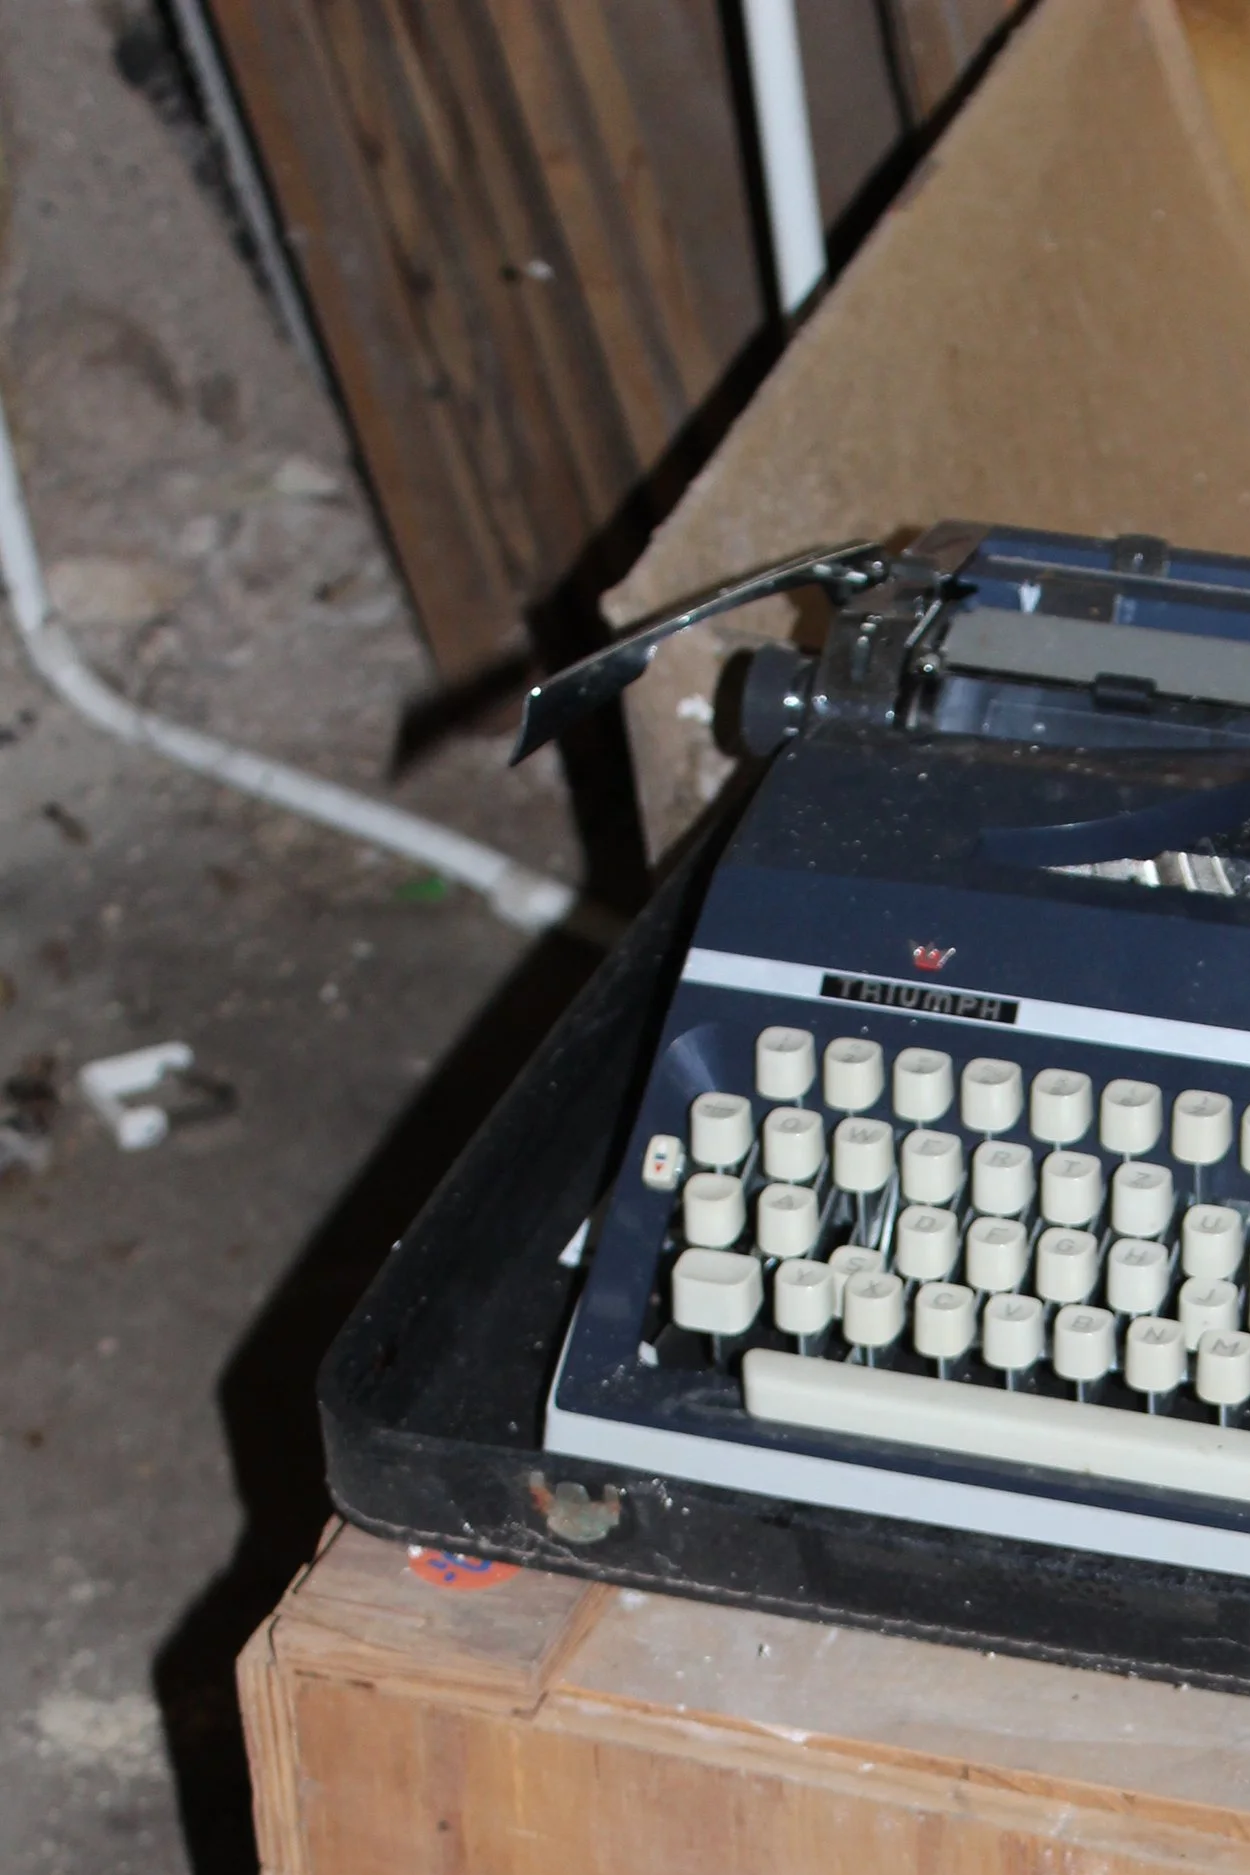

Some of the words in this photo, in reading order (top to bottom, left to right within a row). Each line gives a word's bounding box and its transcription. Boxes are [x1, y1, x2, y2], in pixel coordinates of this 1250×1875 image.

[837, 977, 1001, 1021] TRIUMPH
[990, 1150, 1011, 1167] R
[1063, 1159, 1081, 1174] T
[915, 1215, 936, 1232] D
[1123, 1247, 1149, 1264] H
